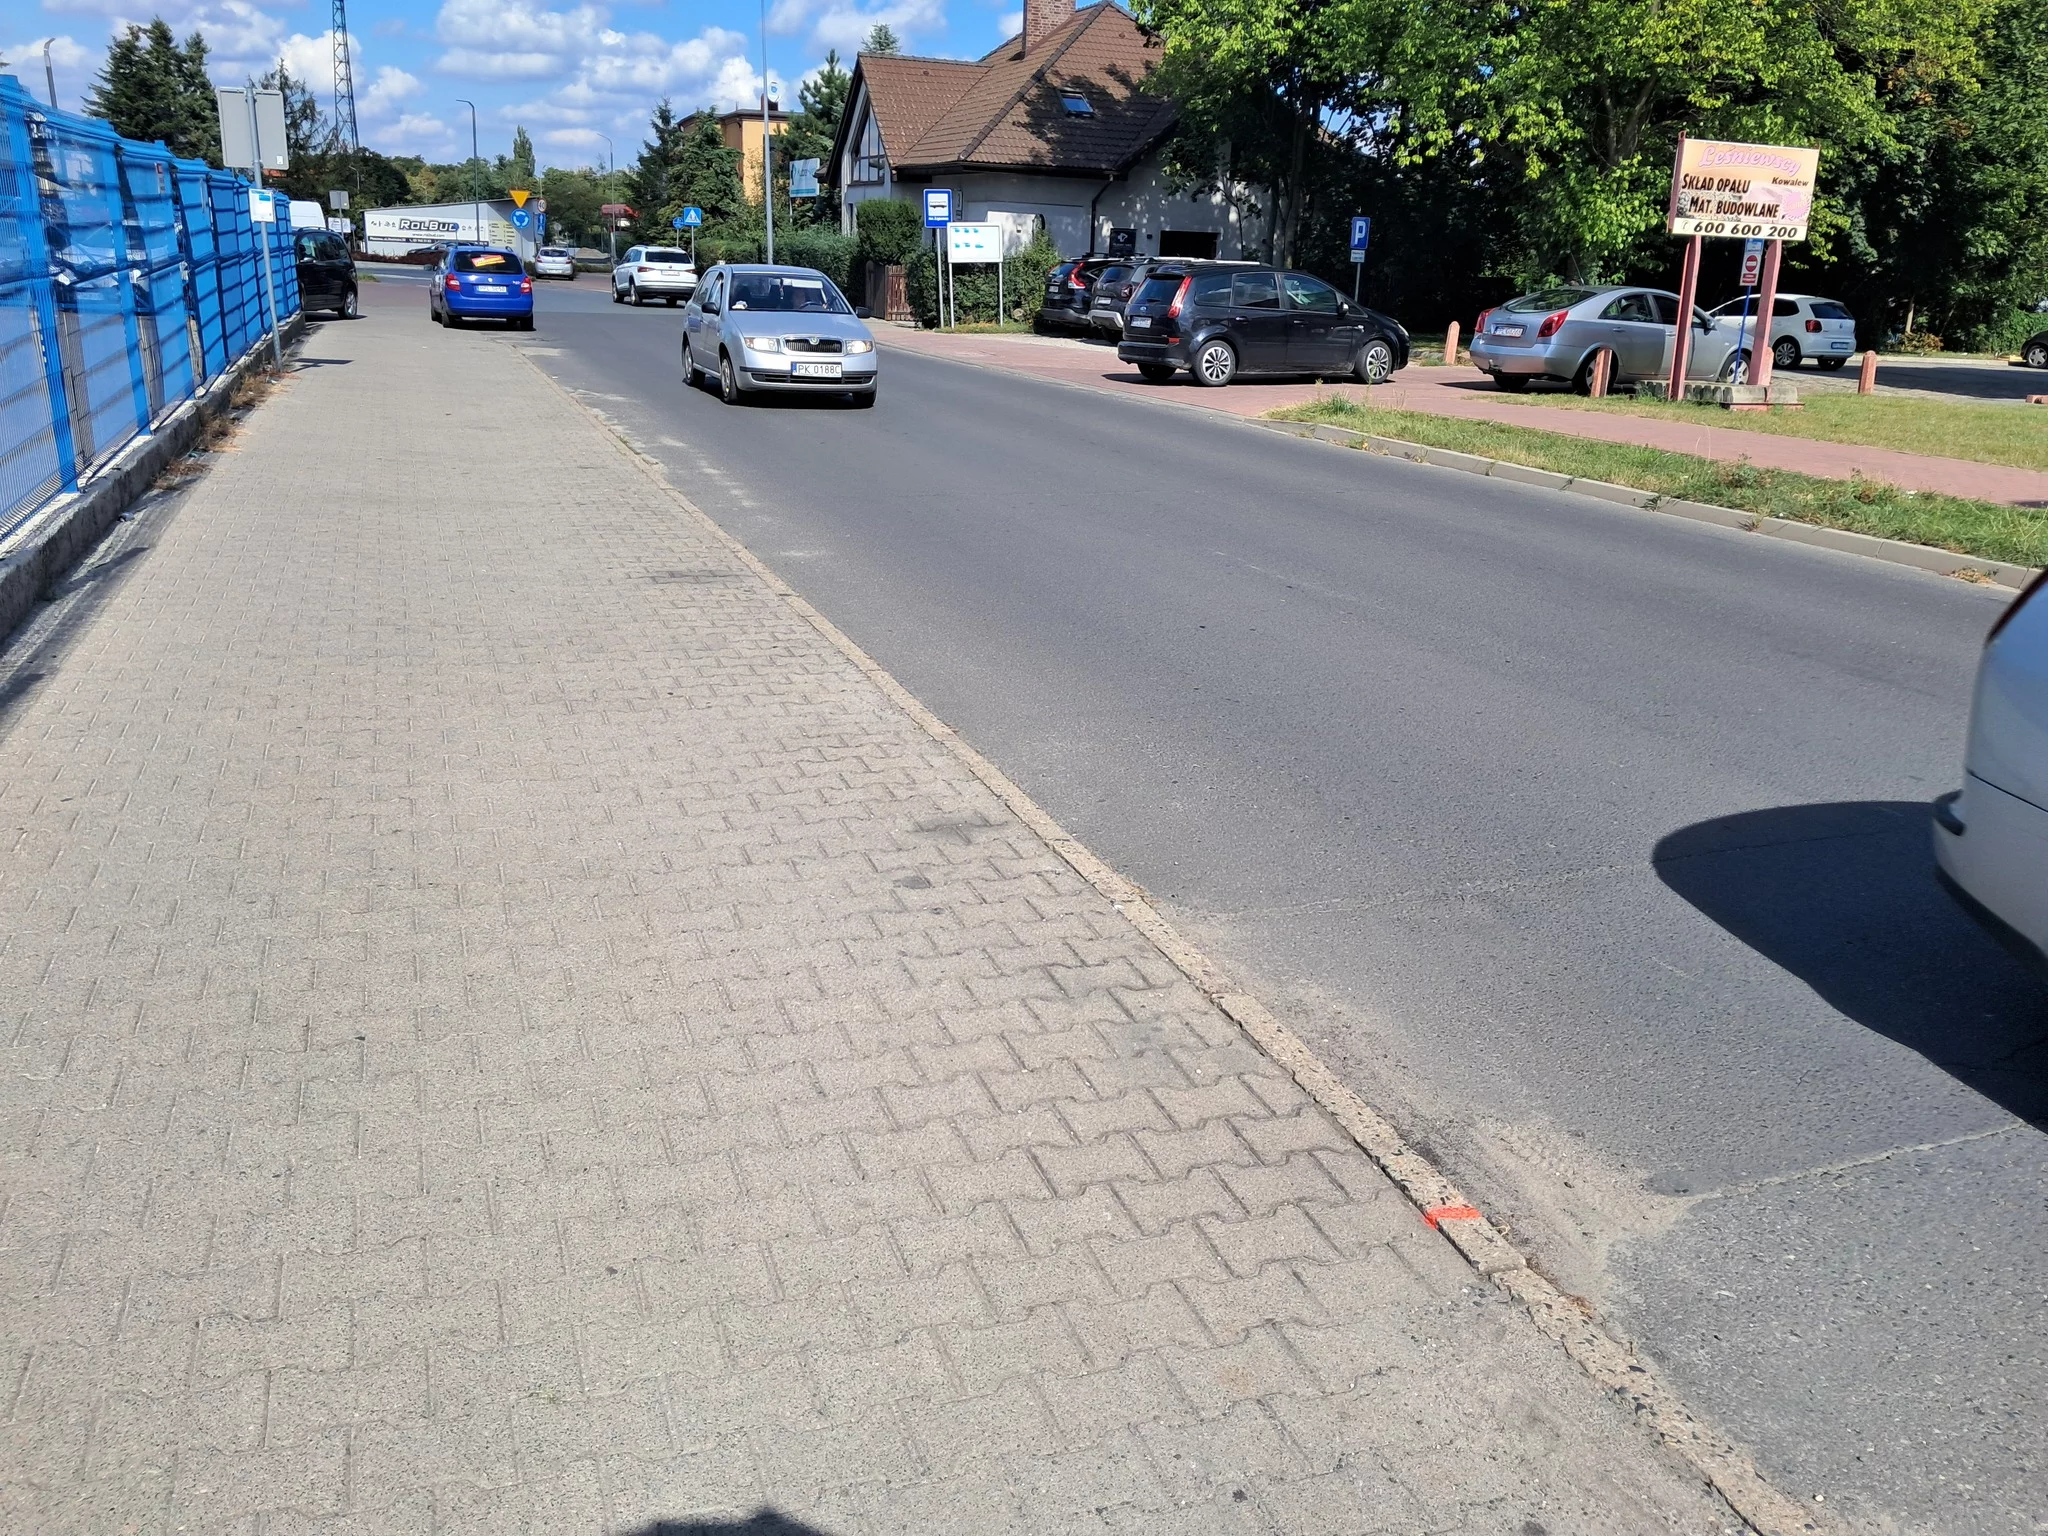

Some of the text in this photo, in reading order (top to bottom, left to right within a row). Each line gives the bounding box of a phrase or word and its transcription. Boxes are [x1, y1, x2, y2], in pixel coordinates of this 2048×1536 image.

[1698, 145, 1801, 177] Leśniewscy
[1681, 173, 1751, 194] SKŁAD OPAŁU
[1771, 176, 1810, 187] Kowalew
[1688, 196, 1713, 215] MAT.
[1715, 201, 1780, 219] BUDOWLANE
[1354, 220, 1366, 245] P
[1693, 221, 1798, 239] 600 600 200
[798, 365, 841, 374] PK 0188C
